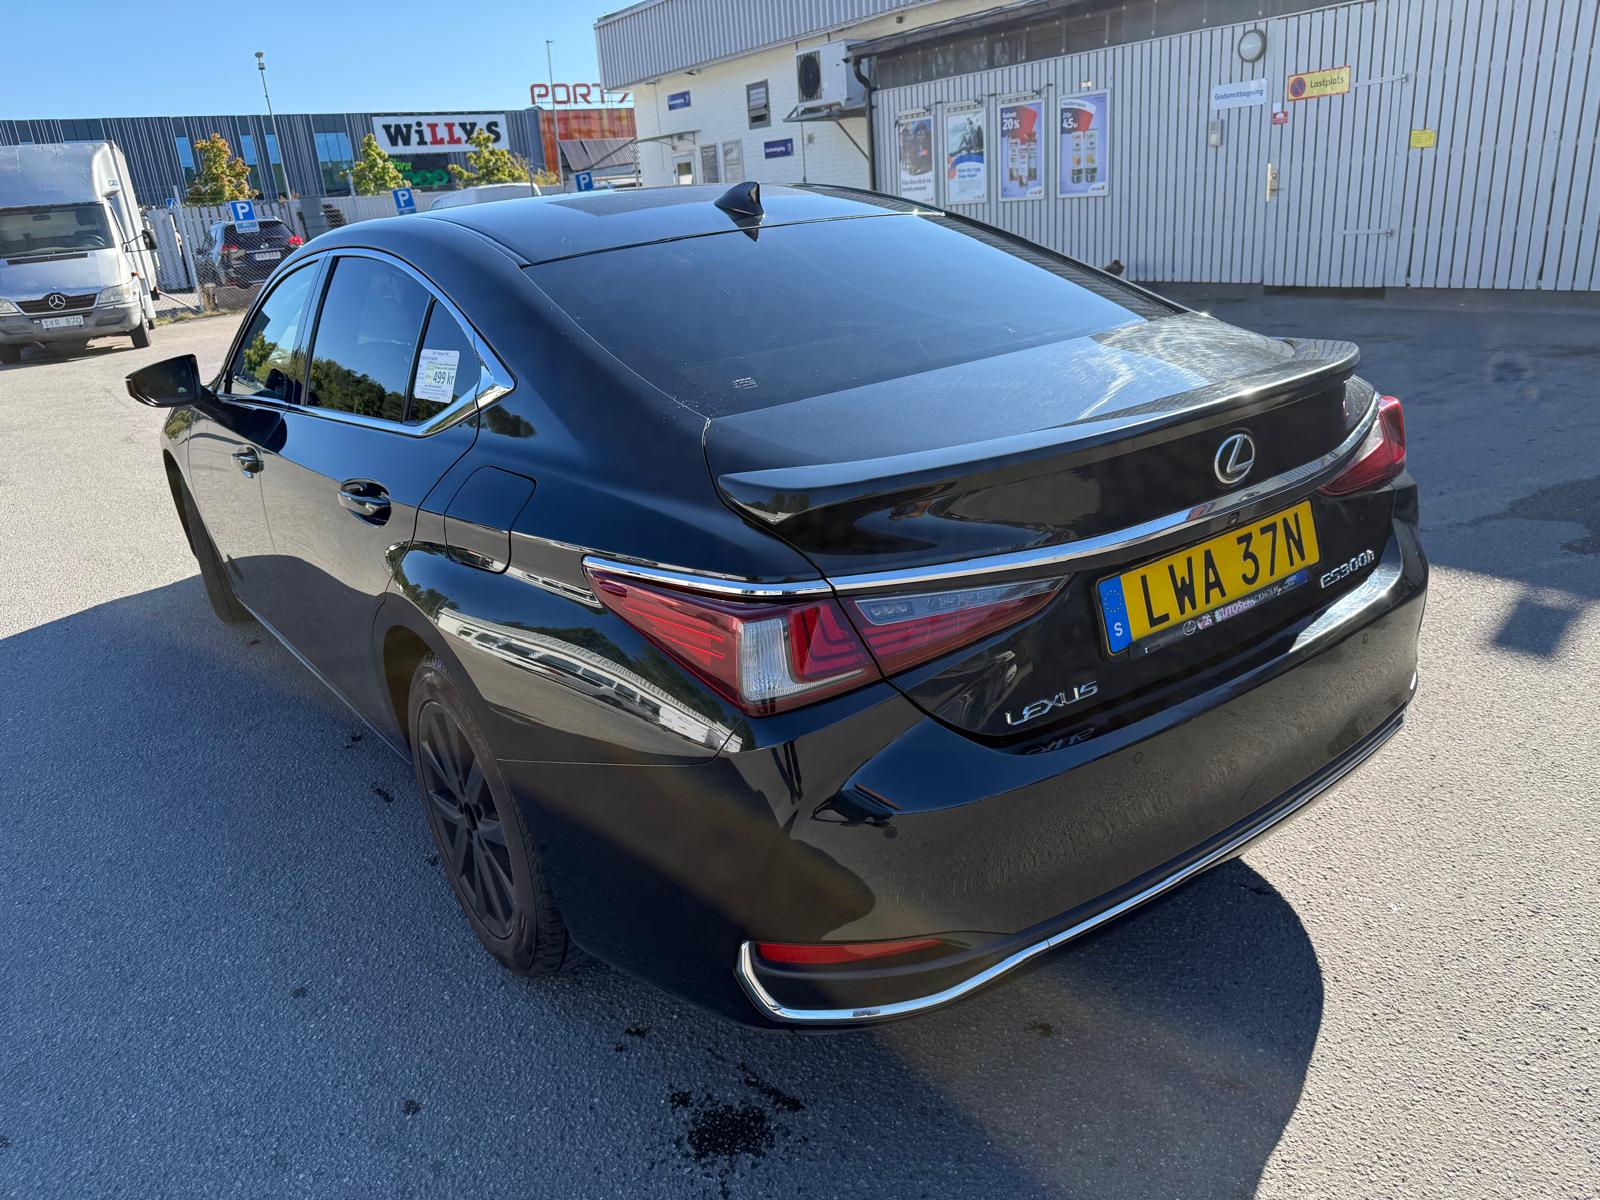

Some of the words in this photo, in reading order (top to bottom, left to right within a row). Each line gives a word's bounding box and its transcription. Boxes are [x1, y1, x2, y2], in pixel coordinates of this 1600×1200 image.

[1310, 76, 1344, 89] Lastplats
[1002, 118, 1020, 131] 20%
[382, 120, 502, 147] WiLLYS
[579, 174, 590, 191] P
[397, 190, 409, 207] P
[236, 203, 250, 220] P
[433, 370, 446, 385] 499
[447, 371, 455, 385] kr
[1140, 548, 1227, 629] LWA
[1236, 512, 1306, 586] 37N
[1320, 549, 1375, 589] ES300h
[1113, 622, 1124, 637] S
[1005, 680, 1098, 726] LEXUS
